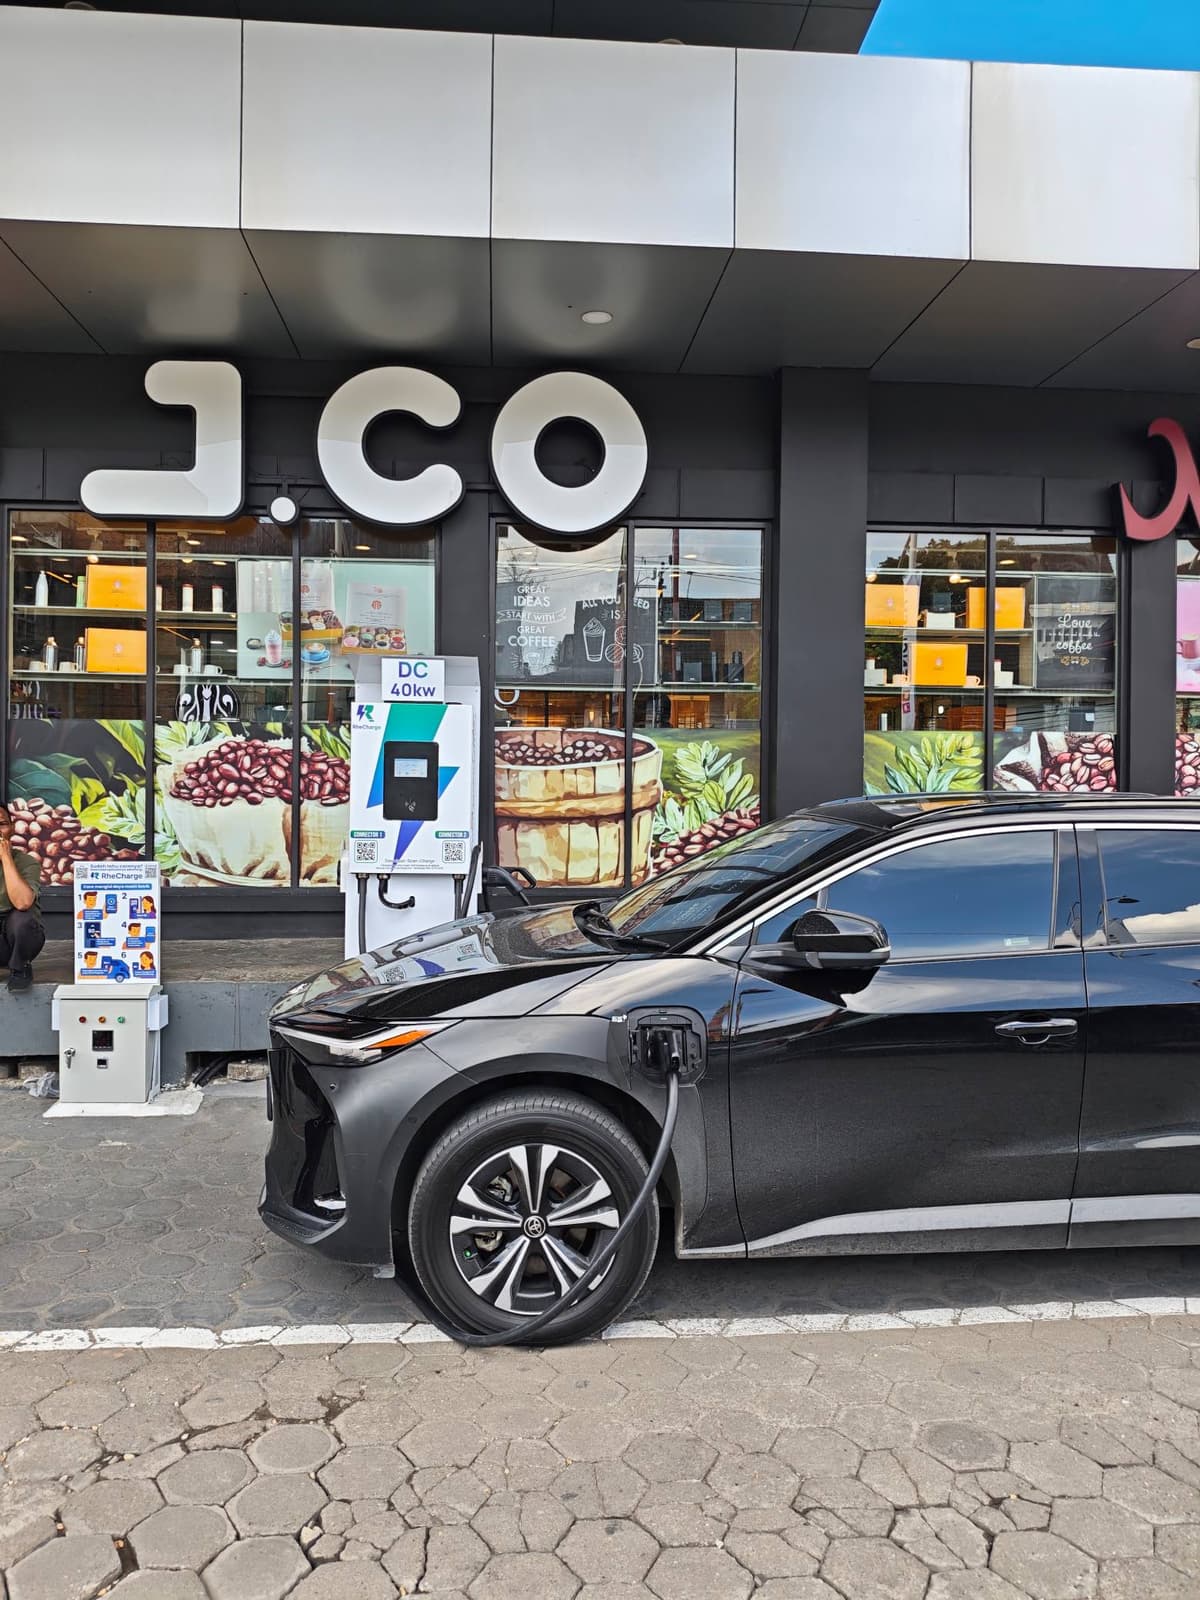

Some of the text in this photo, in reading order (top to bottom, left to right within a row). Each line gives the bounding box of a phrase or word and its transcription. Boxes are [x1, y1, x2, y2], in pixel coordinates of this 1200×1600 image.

[80, 361, 648, 533] J.CO
[517, 585, 546, 594] GREAT
[513, 595, 551, 607] IDEAS
[582, 594, 650, 610] ALL YOU EED
[506, 610, 531, 620] START
[611, 609, 621, 620] IS
[1057, 613, 1093, 628] Love
[516, 625, 546, 634] GREAT
[507, 635, 556, 647] COFFEE
[1056, 640, 1093, 654] coffee
[398, 661, 429, 678] DC
[101, 872, 143, 881] RheCharge
